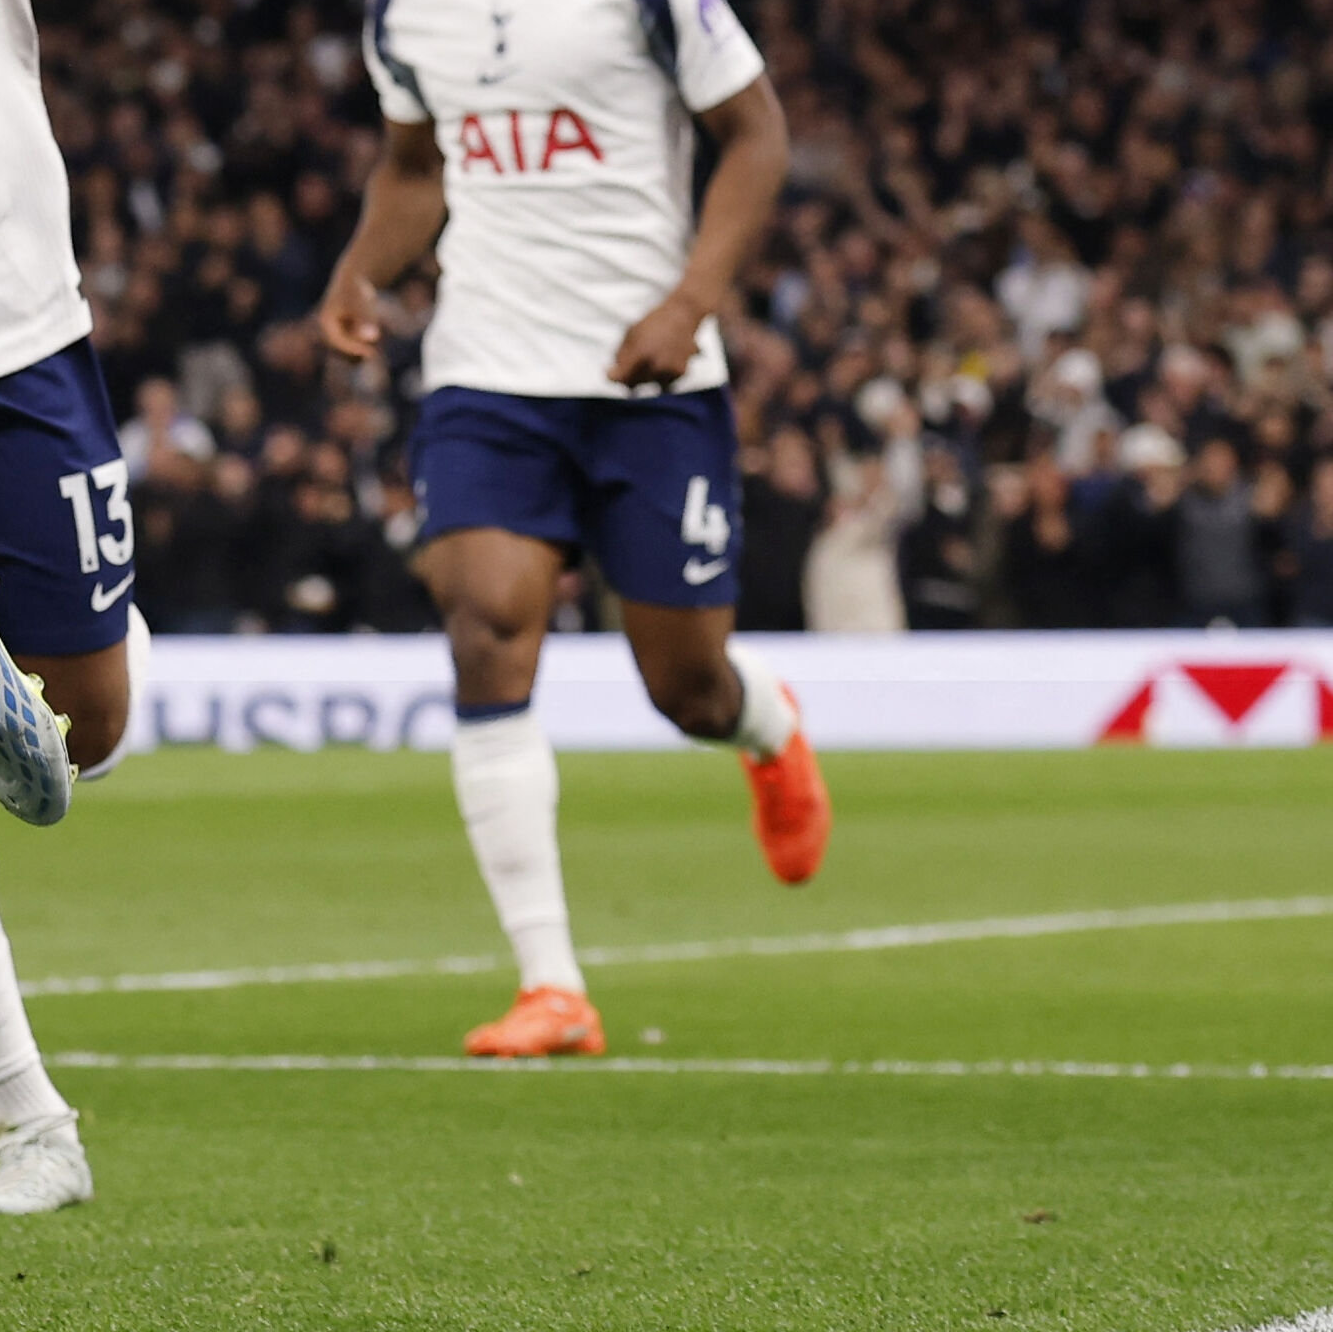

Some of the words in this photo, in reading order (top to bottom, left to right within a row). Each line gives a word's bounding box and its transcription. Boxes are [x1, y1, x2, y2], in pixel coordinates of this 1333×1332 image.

[462, 106, 604, 173] AIA
[58, 458, 134, 574] 13
[681, 475, 731, 556] 4
